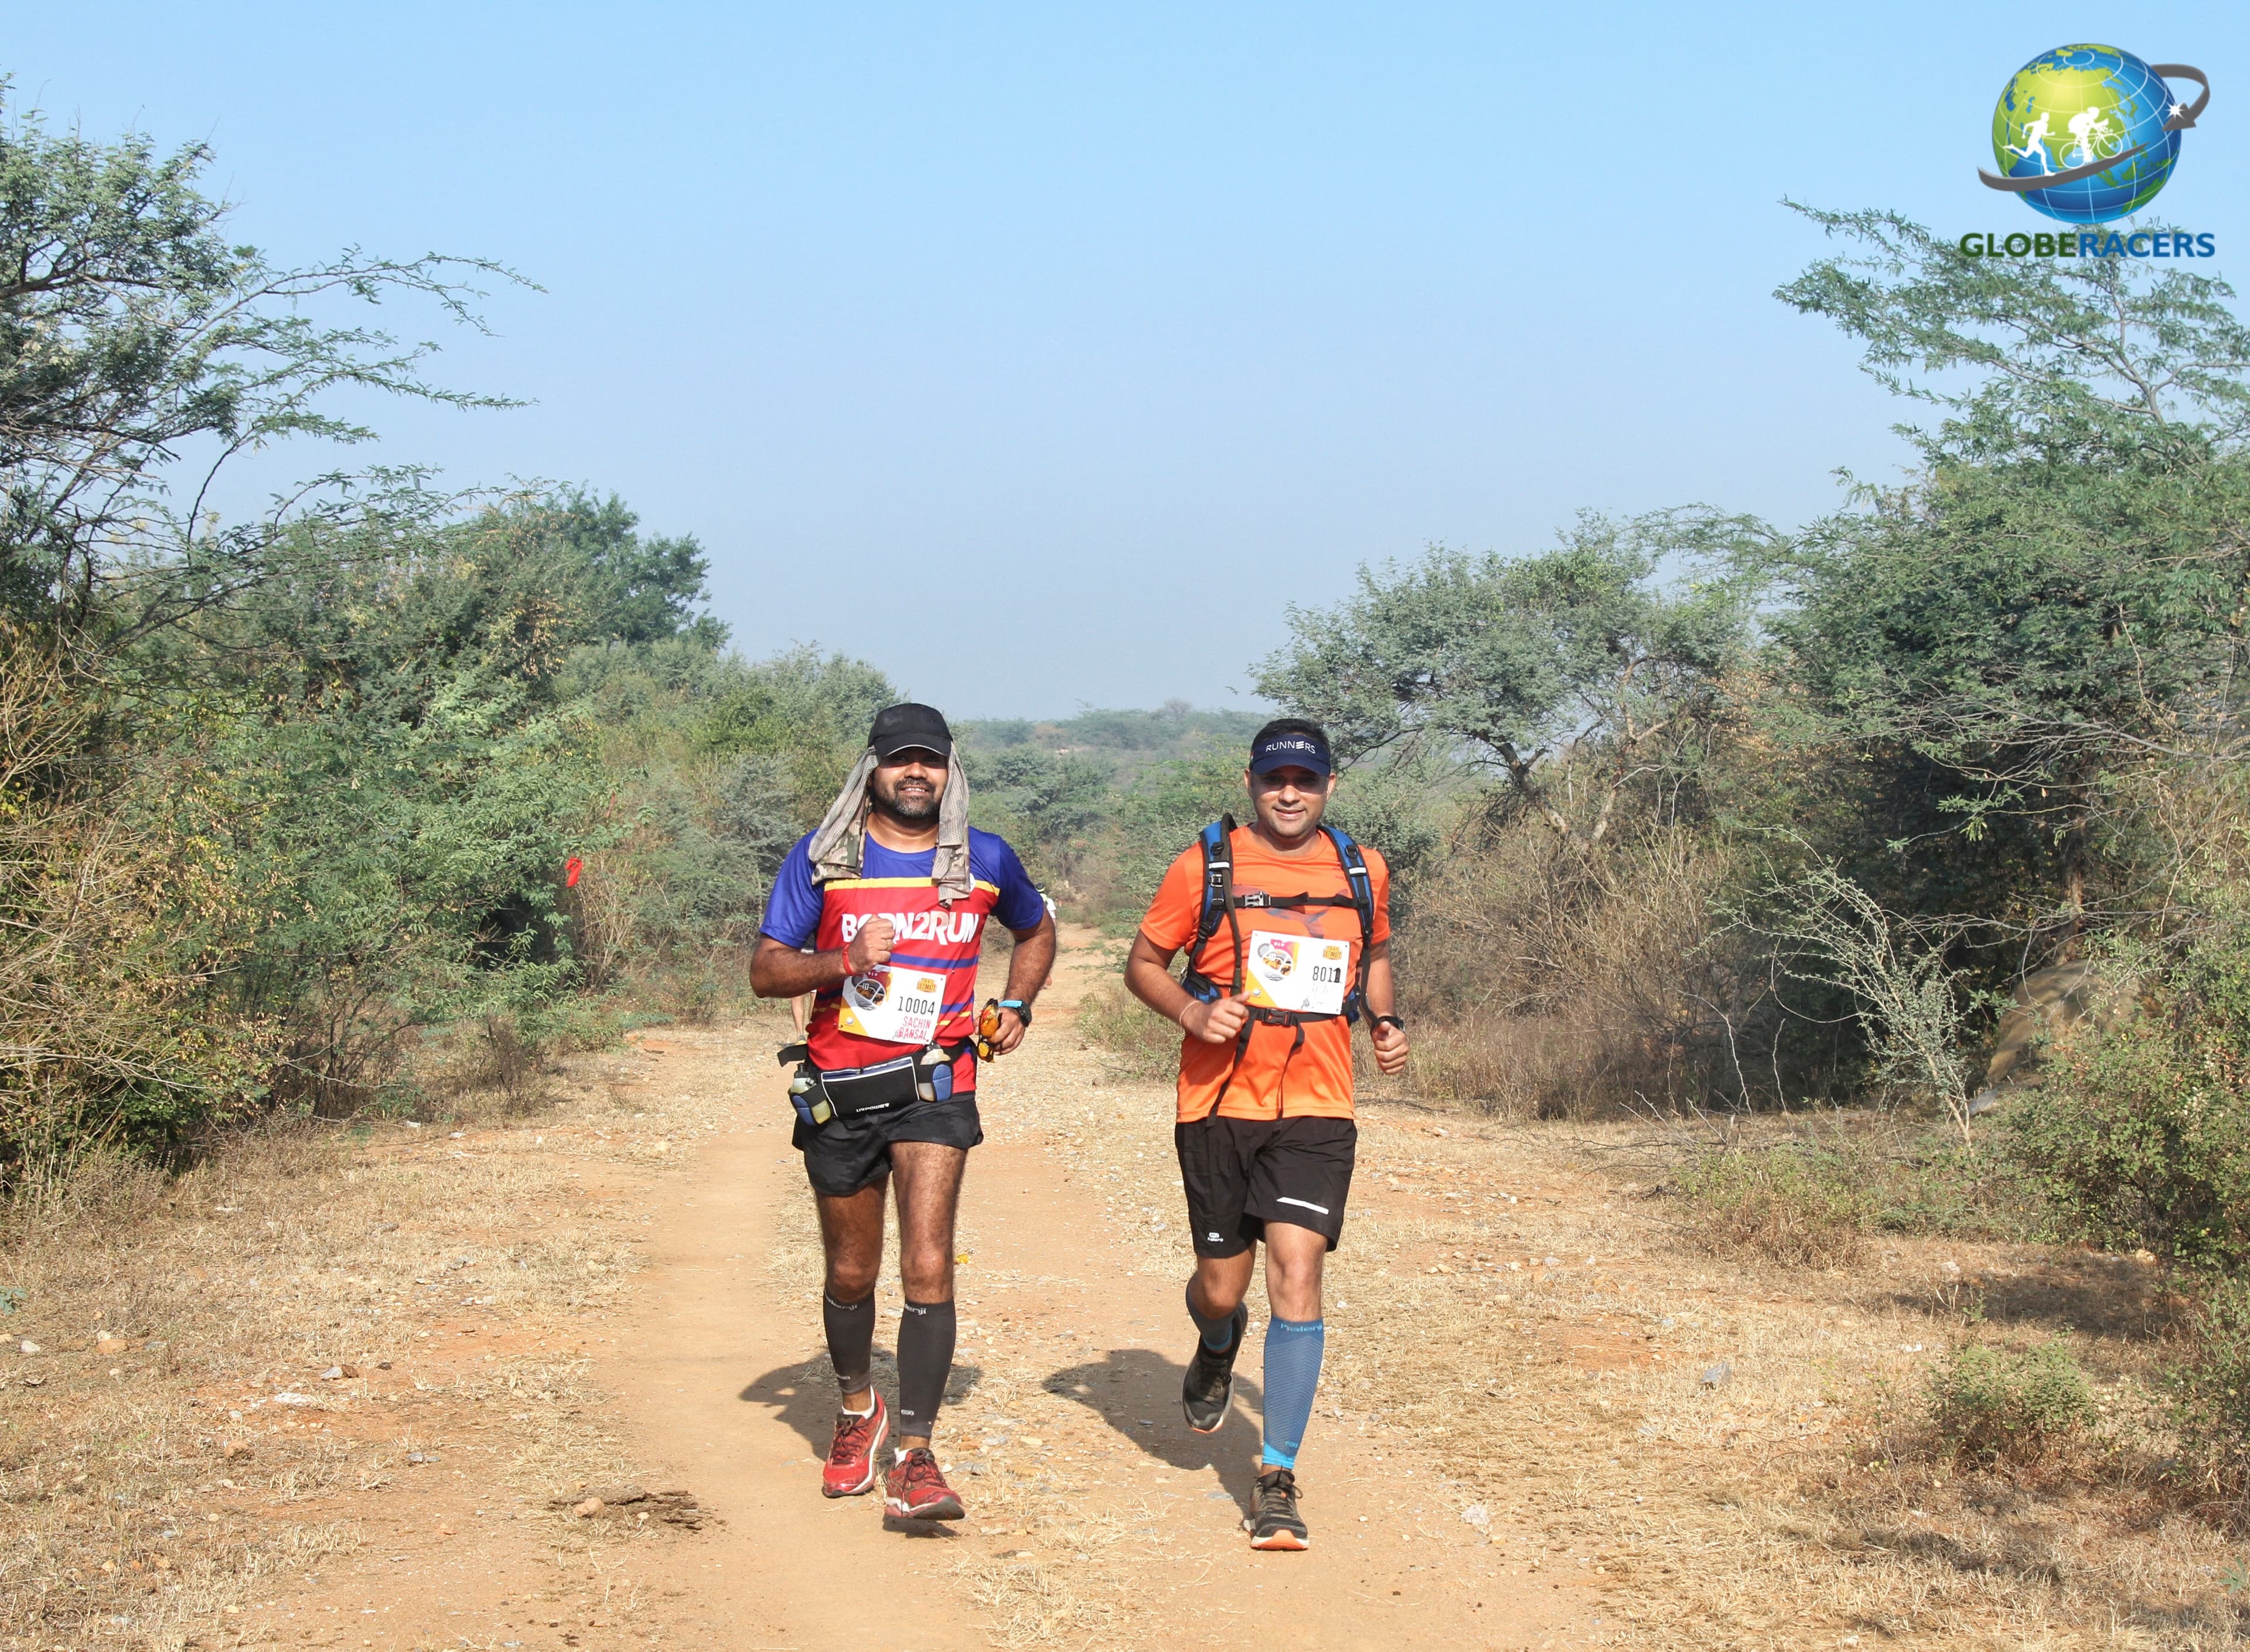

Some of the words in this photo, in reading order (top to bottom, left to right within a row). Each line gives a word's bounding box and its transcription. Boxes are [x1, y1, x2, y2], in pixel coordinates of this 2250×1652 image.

[1266, 740, 1316, 754] RUNNERS
[897, 996, 935, 1016] 10004
[902, 1016, 932, 1030] SACHIN
[898, 1028, 928, 1040] BANSAL
